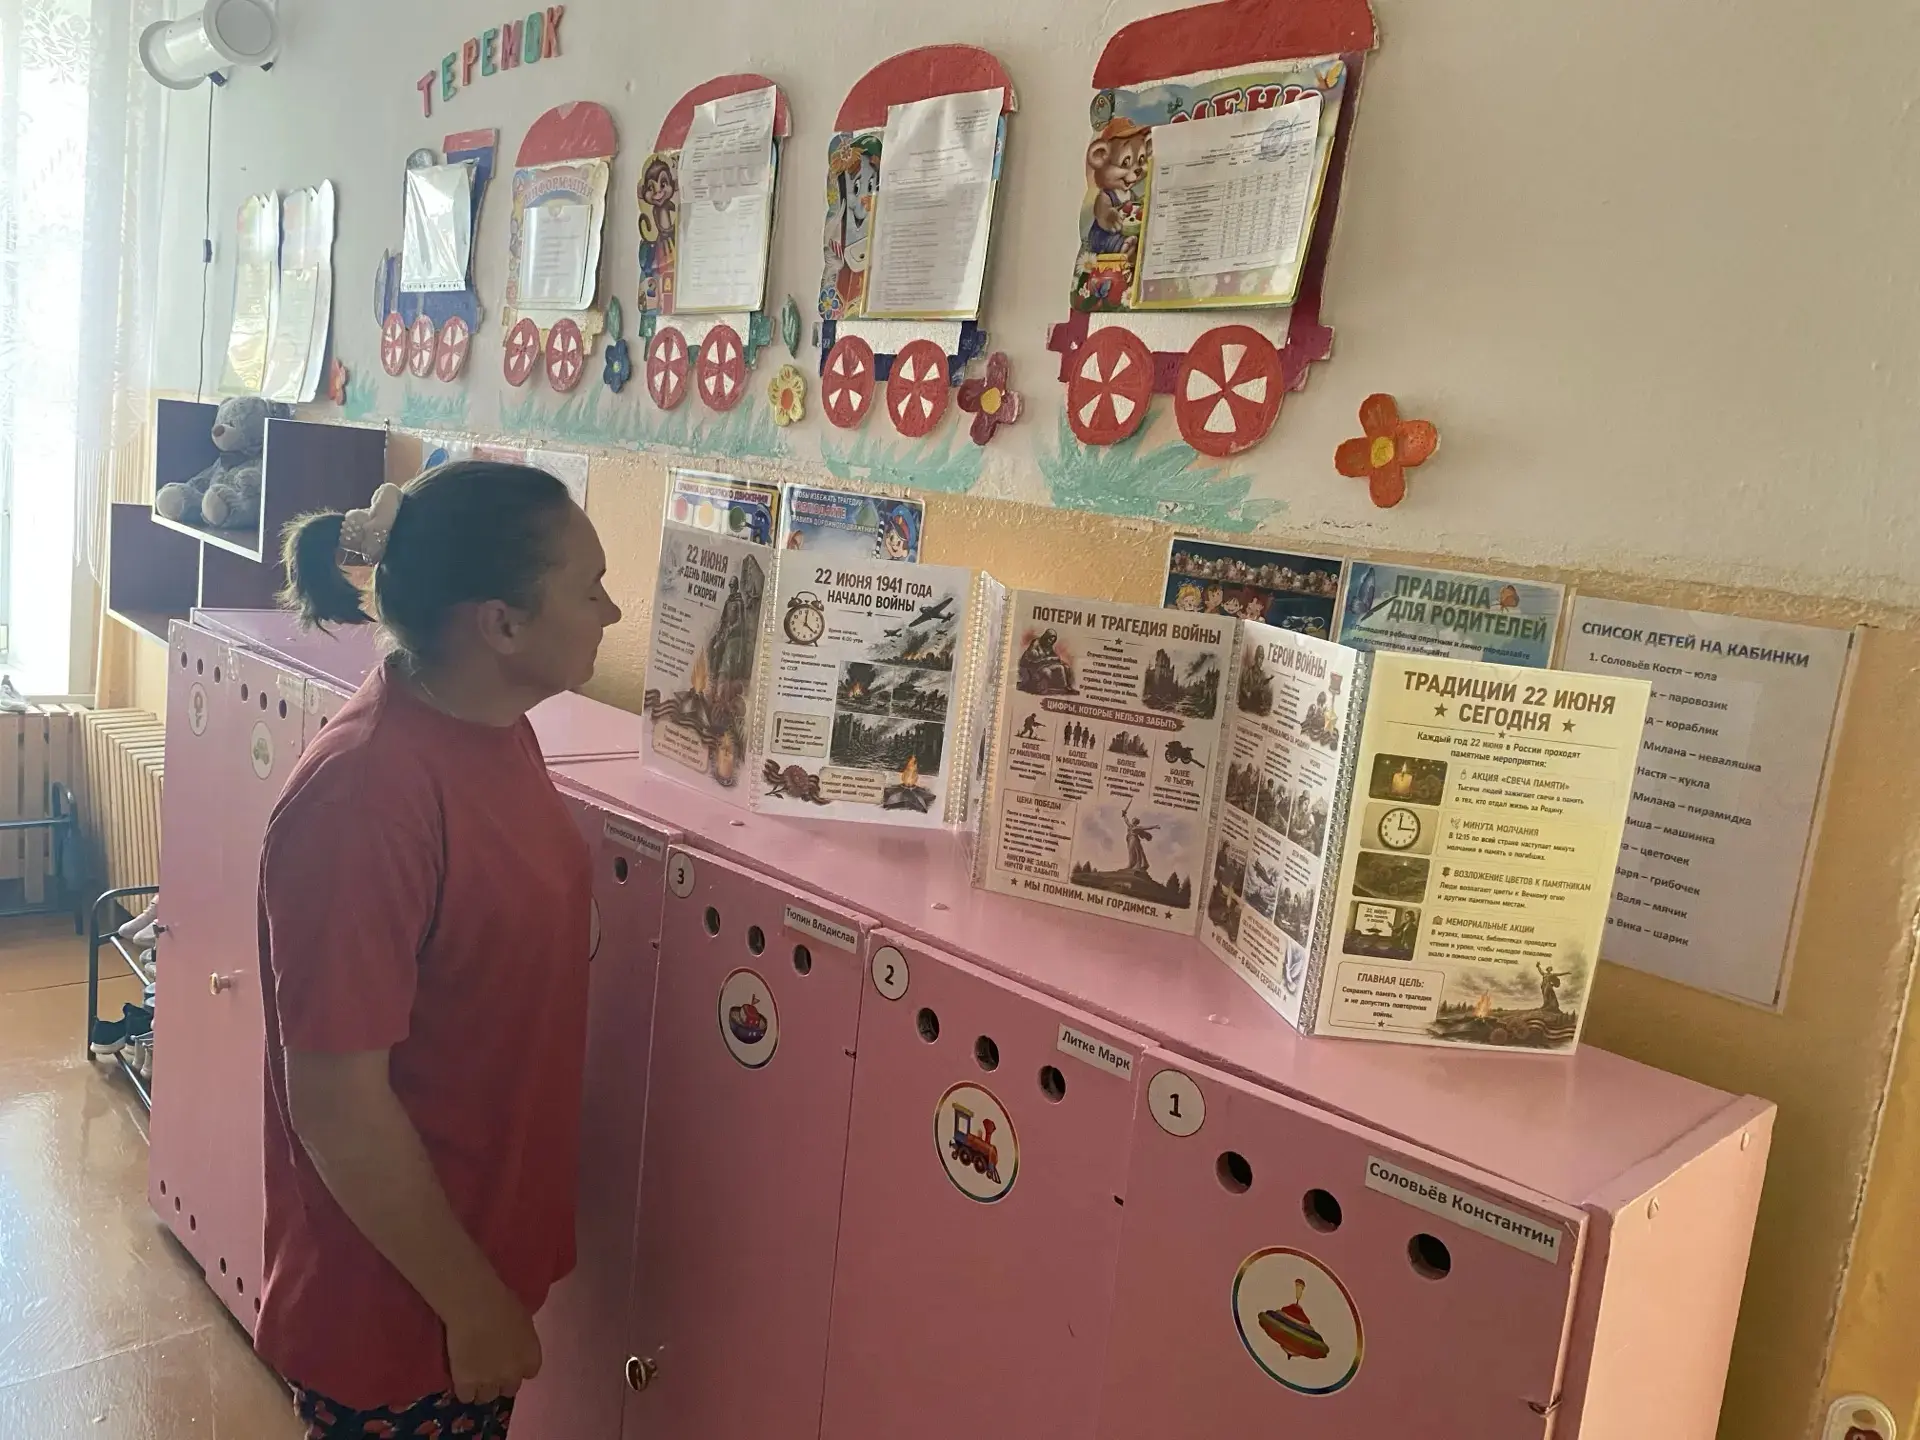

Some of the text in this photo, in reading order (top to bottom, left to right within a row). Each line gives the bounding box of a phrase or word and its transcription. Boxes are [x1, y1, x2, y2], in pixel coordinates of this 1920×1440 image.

[417, 5, 564, 118] ТЕРЕМОК
[686, 544, 729, 574] 22 ИЮНЯ
[683, 565, 726, 590] ДЕНЬ ПАМЯТИ
[815, 568, 932, 598] 22 ИЮНЯ 1941 ГОДА
[688, 582, 717, 603] И СКОРБИ
[827, 589, 916, 613] НАЧАЛО ВОЙНЫ
[1393, 574, 1492, 610] ПРАВИЛА
[1032, 605, 1222, 645] ПОТЕРИ И ТРАГЕДИЯ ВОЙНЫ
[1387, 599, 1549, 643] ДЛЯ РОДИТЕЛЕЙ
[1581, 622, 1811, 669] СПИСОК ДЕТЕЙ НА КАБИНКИ
[1267, 642, 1328, 680] ГЕРОИ ВОЙНЫ
[1588, 652, 1718, 682] 1. Соловьёв Костя юла
[1403, 670, 1616, 715] ТРАДИЦИИ 22 ИЮНЯ
[1668, 692, 1728, 711] паровозик
[1047, 700, 1177, 729] ЦИФРЫ, КОТОРЫЕ НЕЛЬЗЯ ЗАБЫТЬ
[1458, 703, 1552, 732] СЕГОДНЯ
[1665, 718, 1719, 737] кораблик
[1417, 731, 1451, 744] Каждый
[1453, 736, 1468, 747] год
[1470, 738, 1481, 747] 22
[1483, 741, 1504, 750] июня
[1513, 743, 1542, 754] России
[1544, 748, 1581, 760] проходят
[1450, 750, 1547, 768] памятные мероприятия:
[1643, 741, 1762, 773] Милана неваляшка
[1471, 772, 1499, 783] АКЦИЯ
[1636, 766, 1711, 790] Настя кукла
[1034, 799, 1061, 810] ПОБЕДЫ
[1633, 791, 1752, 827] Милана пирамидка
[1463, 820, 1539, 837] МИНУТА МОЛЧАНИЯ
[1663, 826, 1716, 846] машинка
[1640, 846, 1690, 867] цветочек
[677, 868, 685, 885] 3
[1453, 869, 1505, 882] ВОЗЛОЖЕНИЕ
[1505, 874, 1533, 886] ЦВЕТОВ
[1542, 880, 1592, 891] ПАМЯТНИКАМ
[1650, 876, 1701, 897] грибочек
[1023, 879, 1159, 918] МЫ ПОМНИМ. МЫ ГОРДИМСЯ.
[1616, 891, 1688, 919] Валя мячик
[786, 907, 855, 945] Тюпин Владислав
[1445, 917, 1535, 934] МЕМОРИАЛЬНЫЕ АКЦИИ
[1616, 918, 1642, 934] Вика
[1652, 928, 1690, 947] шарик
[884, 964, 894, 985] 2
[1357, 972, 1424, 988] ГЛАВНАЯ ЦЕЛЬ:
[1062, 1030, 1131, 1071] Литке Марк
[1168, 1093, 1182, 1118] 1
[1369, 1161, 1556, 1248] Соловьёв Константин
